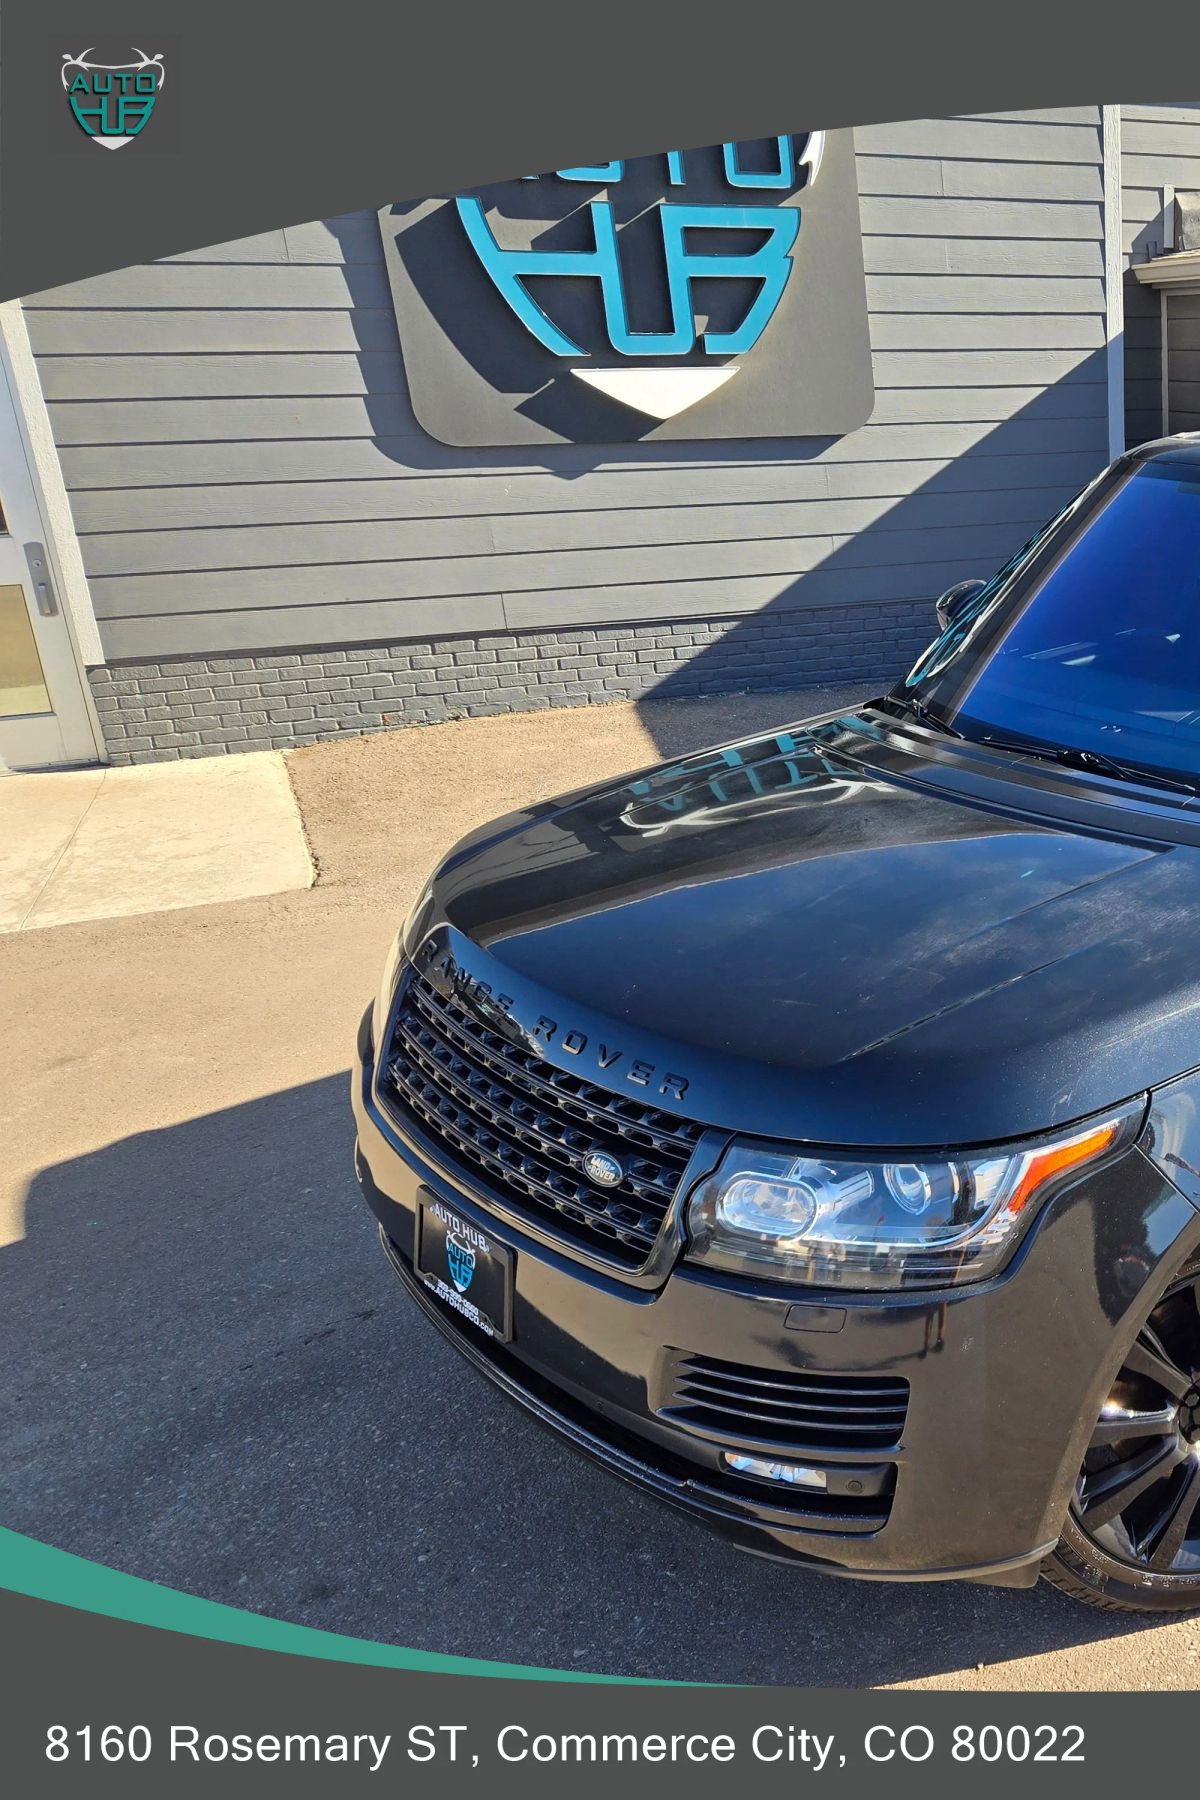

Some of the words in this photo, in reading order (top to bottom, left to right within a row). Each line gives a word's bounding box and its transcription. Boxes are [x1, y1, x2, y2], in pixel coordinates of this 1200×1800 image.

[456, 196, 801, 357] HUB
[532, 1015, 690, 1101] ROVER
[590, 1155, 612, 1170] LAND
[590, 1165, 616, 1182] ROVER
[434, 1204, 461, 1233] AUTO
[462, 1223, 486, 1252] HUB
[449, 1244, 474, 1268] AUTO
